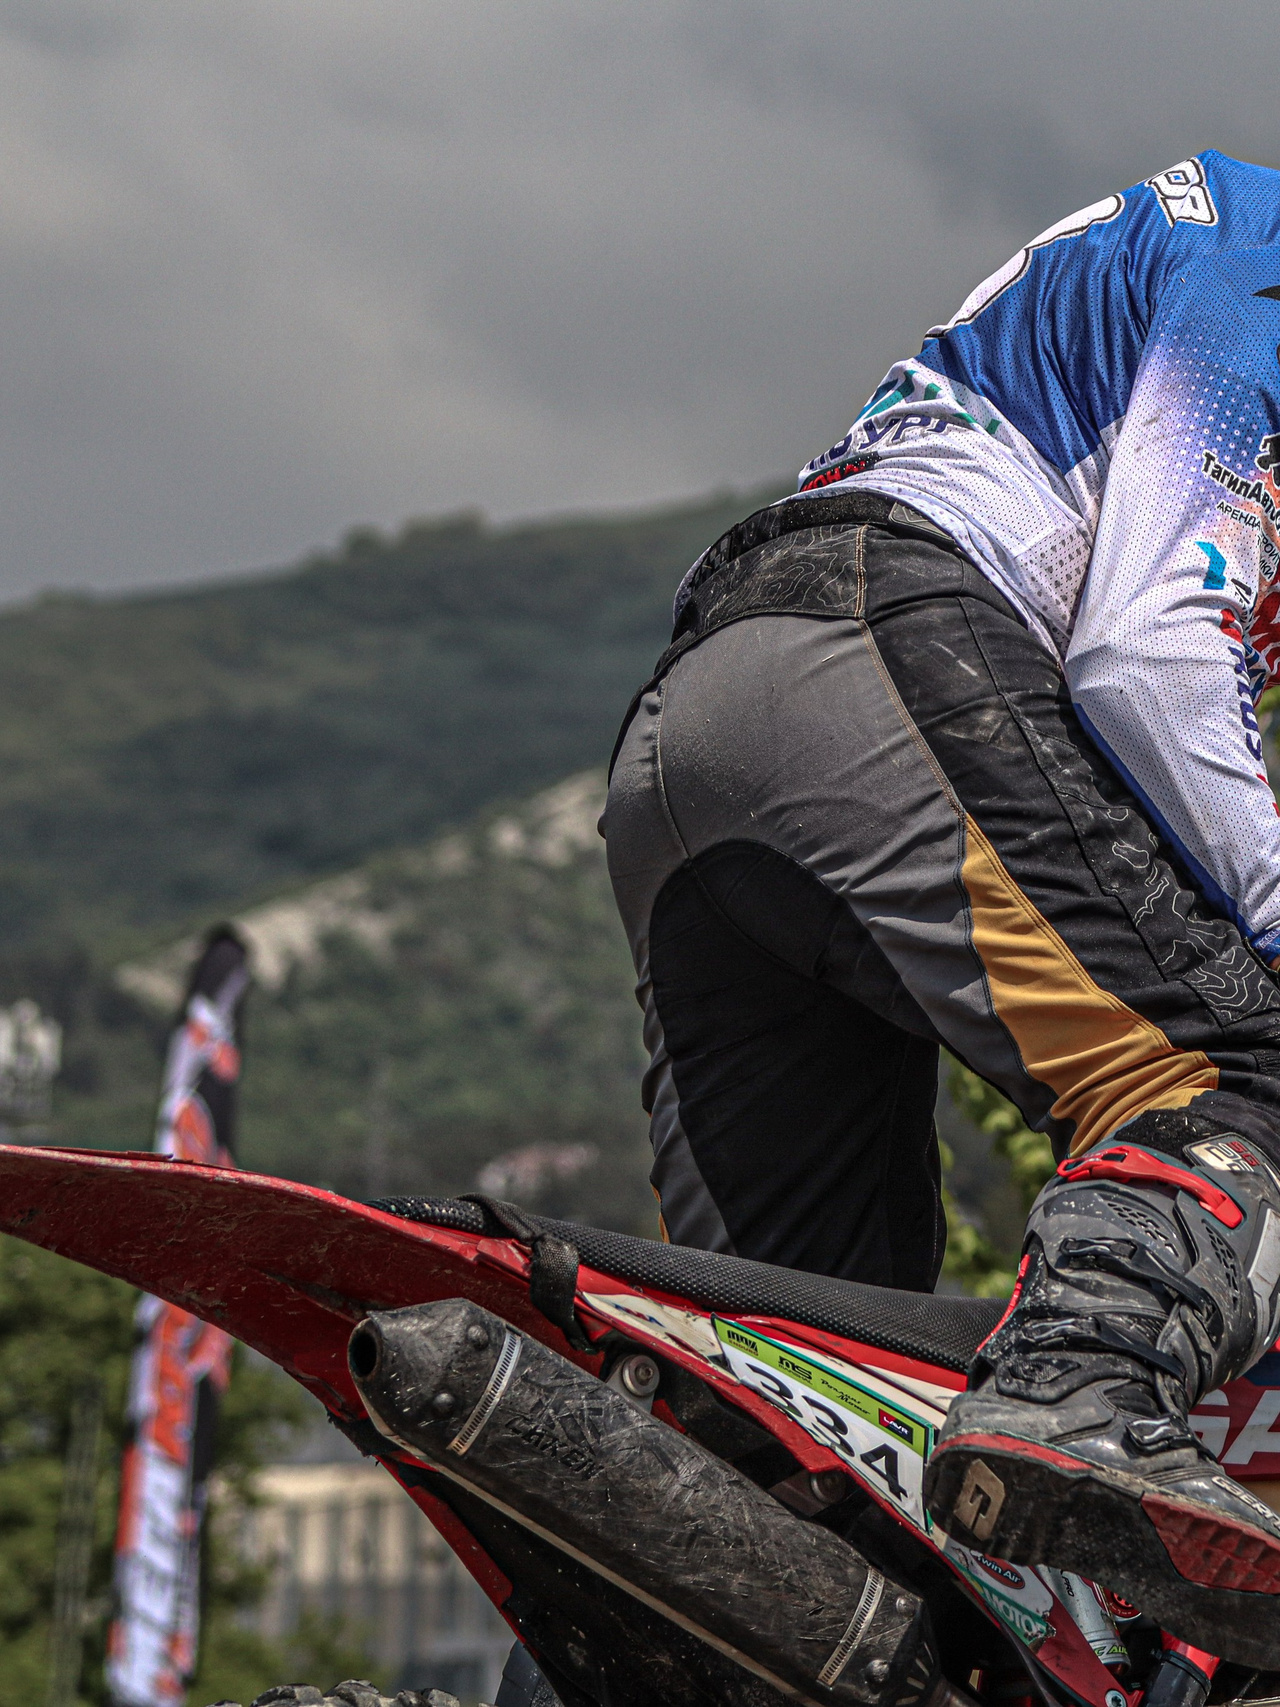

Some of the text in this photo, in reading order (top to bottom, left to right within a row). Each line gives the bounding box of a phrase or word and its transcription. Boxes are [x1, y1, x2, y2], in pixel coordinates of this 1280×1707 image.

[745, 1362, 908, 1500] 334
[883, 1415, 909, 1436] LAVR
[1002, 1568, 1022, 1584] Air
